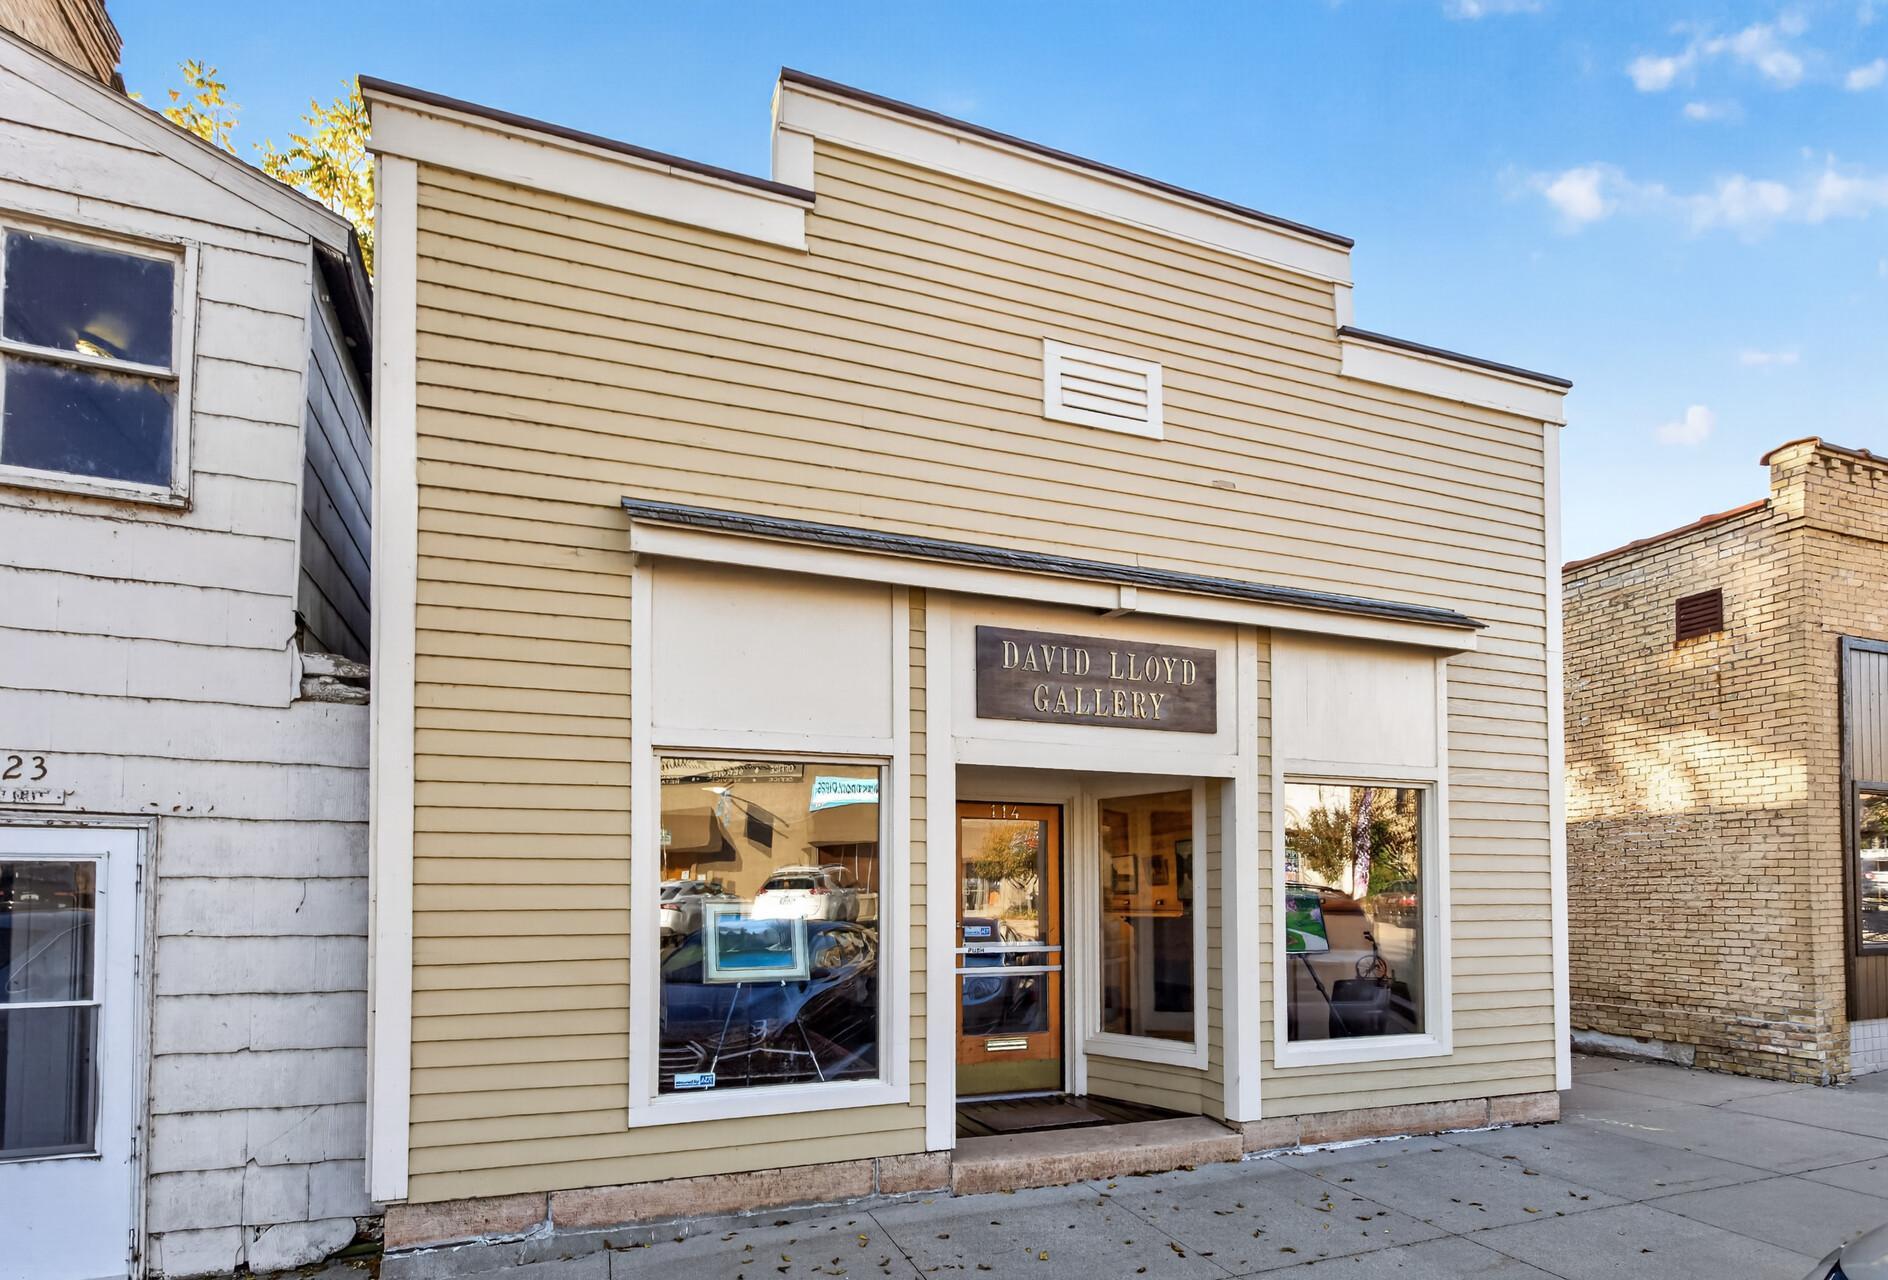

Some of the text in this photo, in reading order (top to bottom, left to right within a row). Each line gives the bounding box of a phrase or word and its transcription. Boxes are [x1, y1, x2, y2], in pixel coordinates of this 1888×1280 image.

[1001, 639, 1197, 687] DAVID LLOYD
[1032, 682, 1166, 721] GALLERY
[1, 754, 48, 781] 23
[991, 804, 1019, 819] 114
